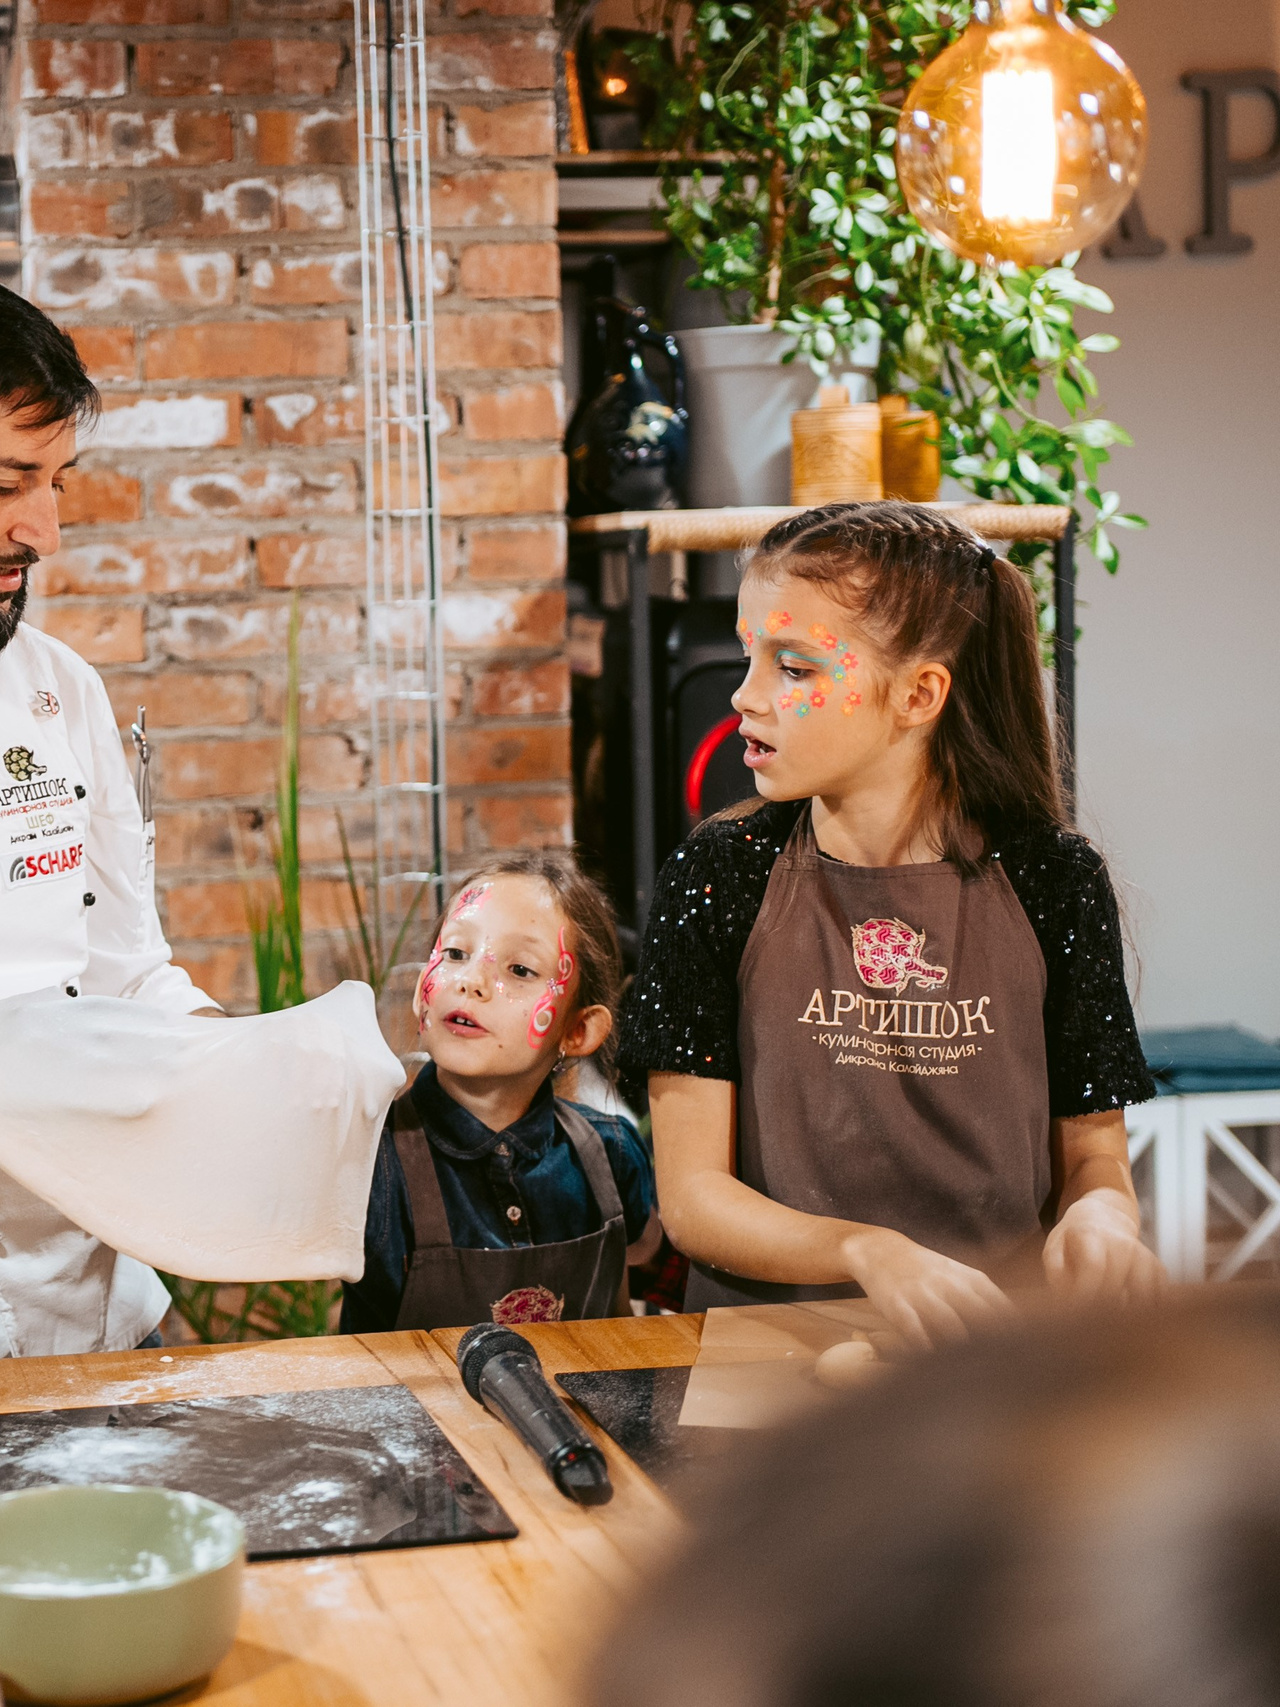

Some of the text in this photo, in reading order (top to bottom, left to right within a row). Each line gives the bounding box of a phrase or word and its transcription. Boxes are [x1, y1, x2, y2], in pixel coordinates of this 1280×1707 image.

[26, 813, 55, 830] ШЕФ
[797, 988, 995, 1039] АРТИШОК
[835, 1052, 959, 1076] Дикрана Калайджяна
